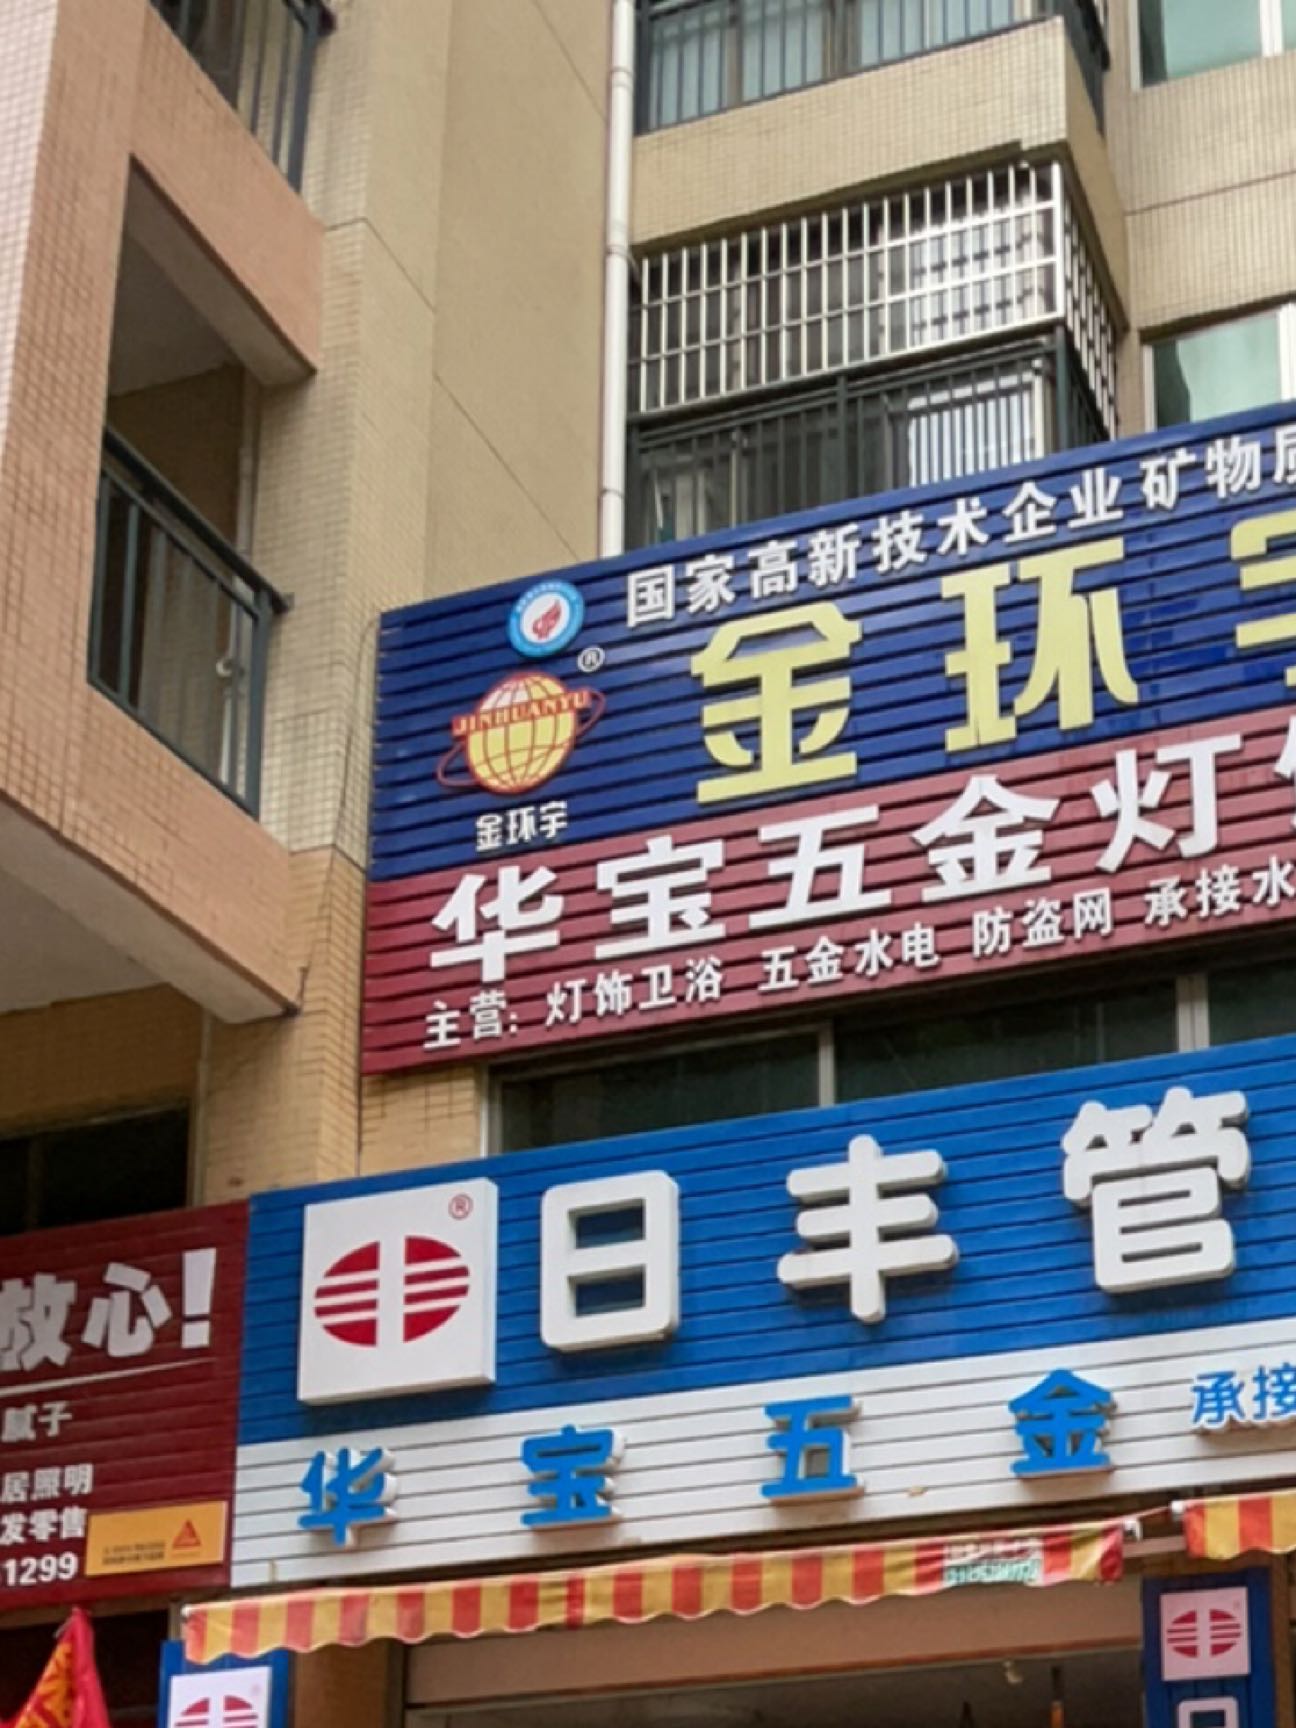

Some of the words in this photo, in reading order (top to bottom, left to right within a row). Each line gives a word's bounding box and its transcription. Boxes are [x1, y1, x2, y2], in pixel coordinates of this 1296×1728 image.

[625, 467, 1124, 629] 国家高新技术企业
[452, 688, 593, 737] JINHUANYU
[475, 800, 569, 853] 金环宇
[757, 920, 942, 993] 五金水电
[970, 886, 1115, 959] 防盗网
[297, 1368, 1115, 1546] 华宝五金
[4, 1551, 79, 1587] 1299
